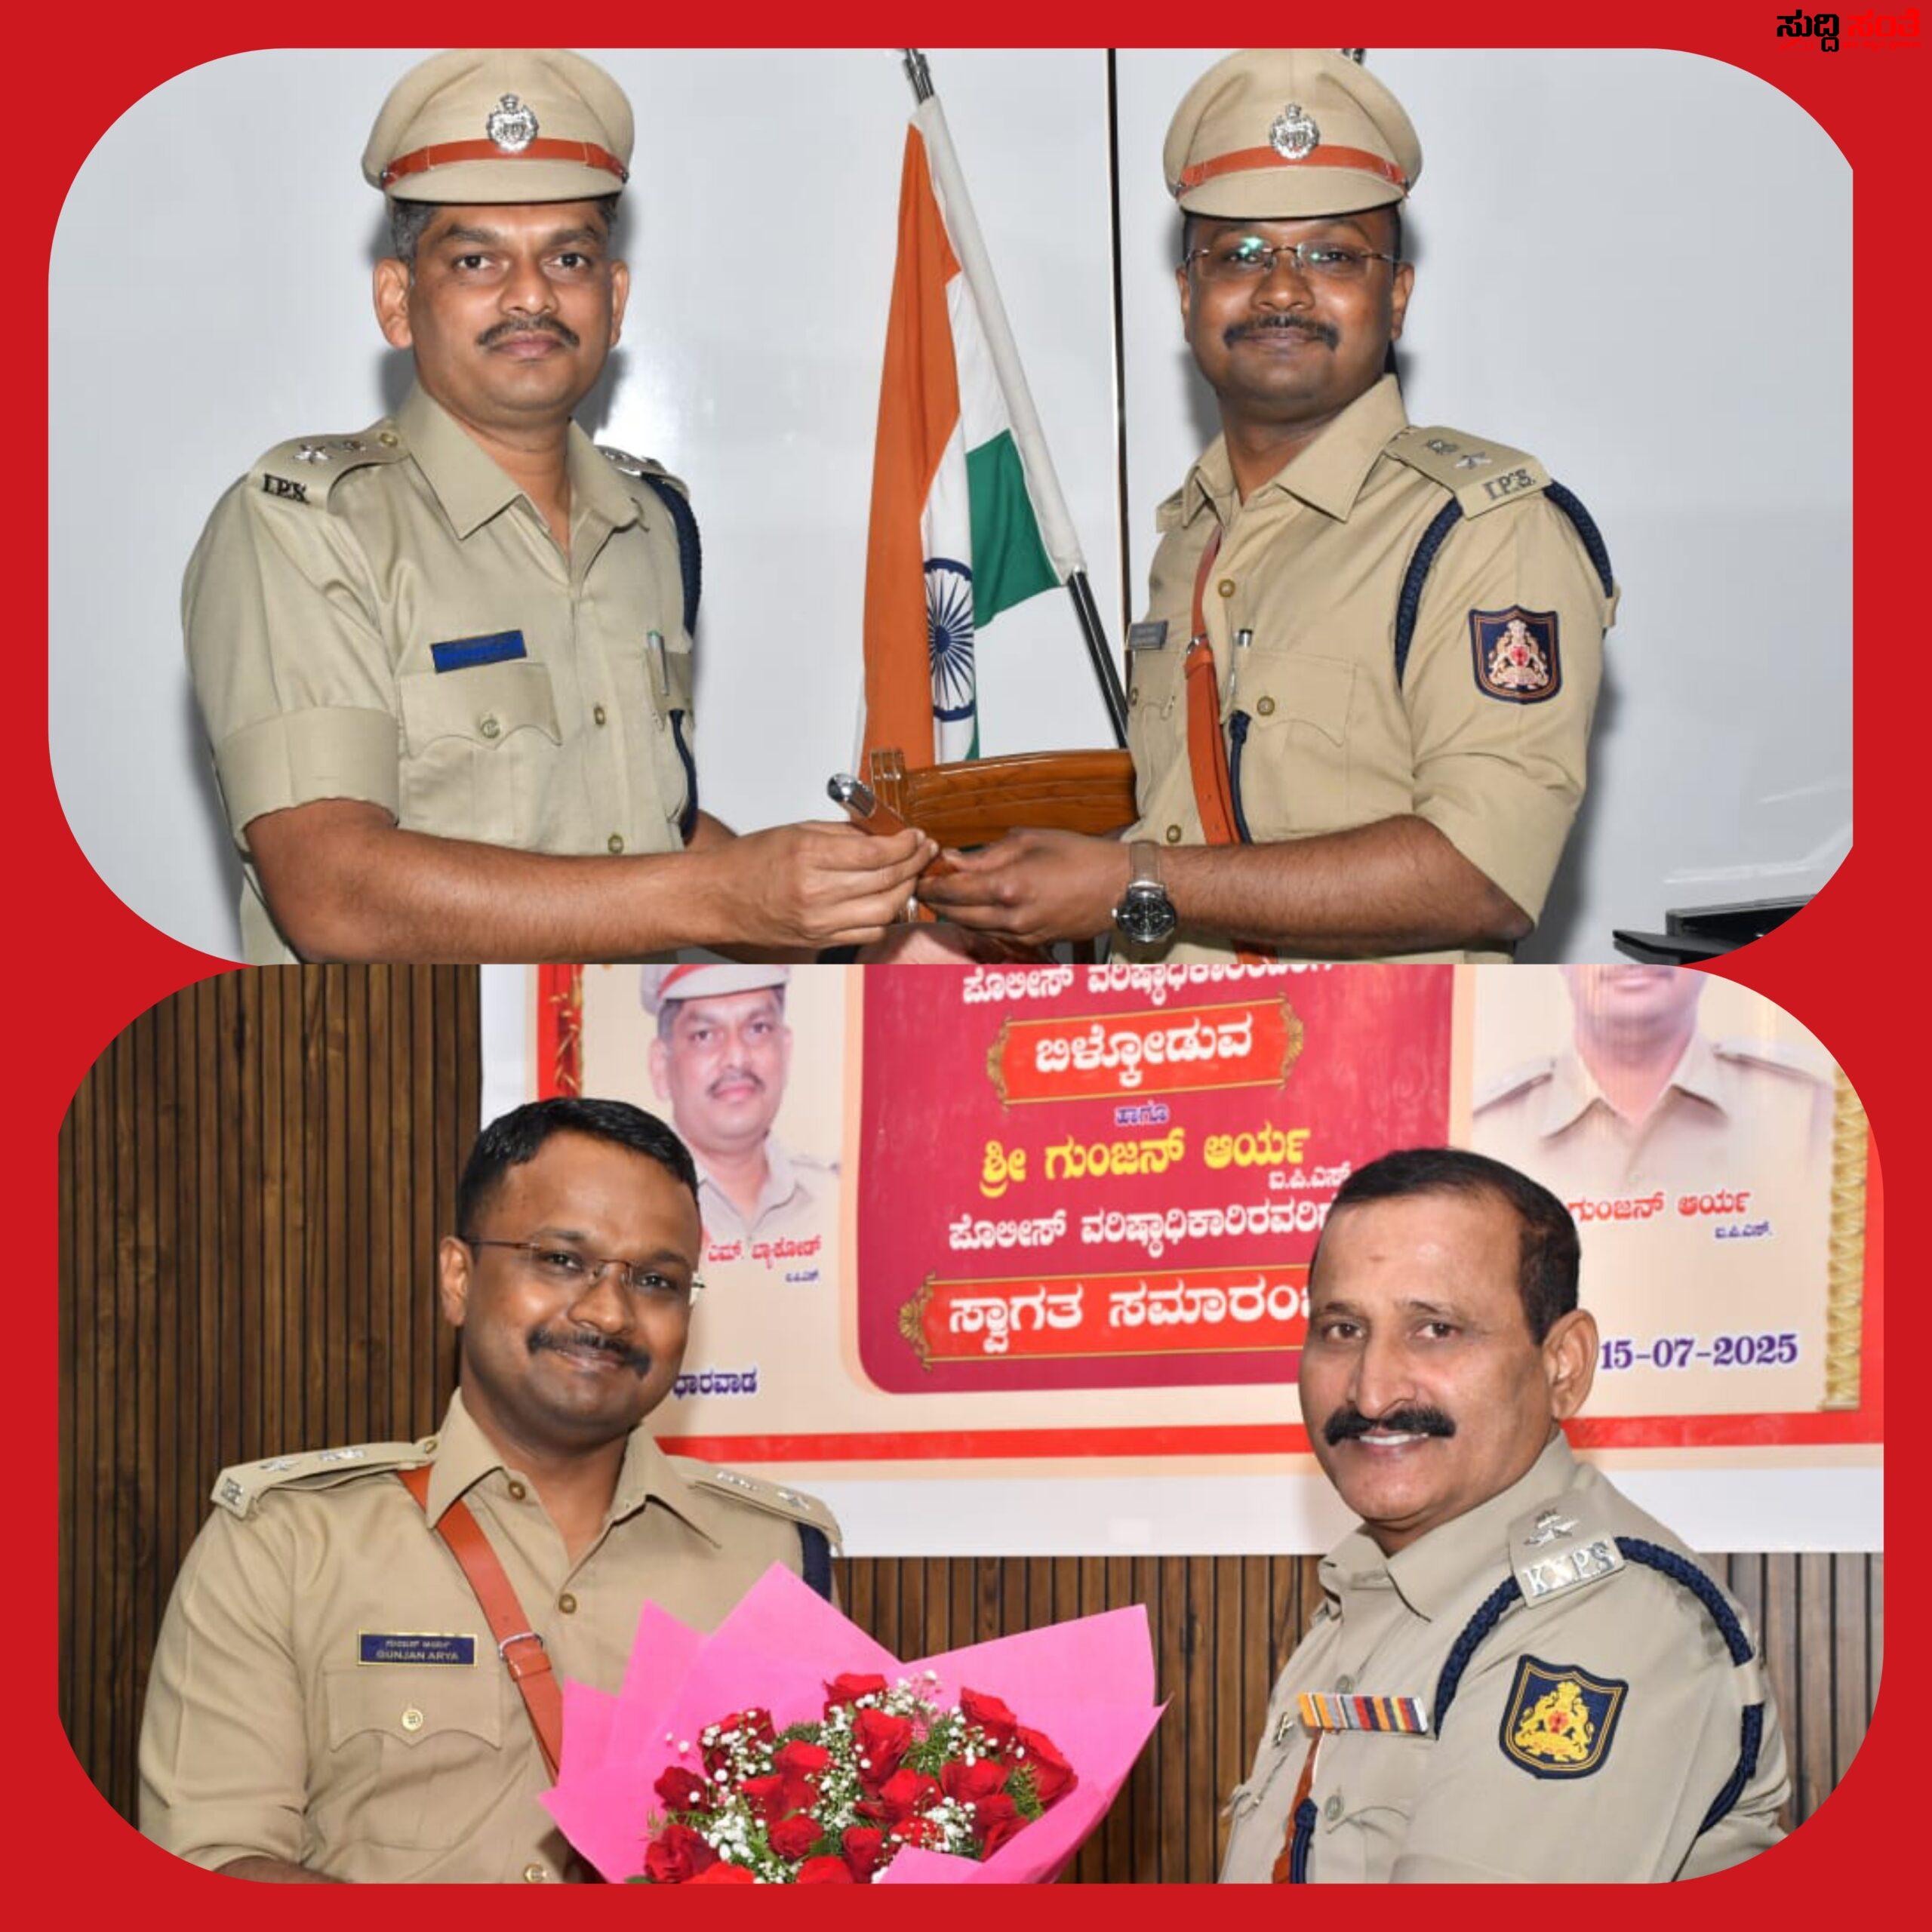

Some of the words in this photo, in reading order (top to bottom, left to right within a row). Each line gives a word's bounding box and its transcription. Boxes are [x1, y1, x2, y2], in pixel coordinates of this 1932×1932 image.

[980, 1140, 1026, 1198] ಶ್ರೀ
[1045, 1128, 1186, 1180] ಗುಂಜನ್
[1204, 1122, 1310, 1170] ಆರ್ಯ
[1567, 1192, 1664, 1222] ಗುಂಜನ್
[1677, 1188, 1751, 1217] ಆರ್ಯ
[949, 1208, 1067, 1251] ಪೊಲೀಸ್
[949, 1283, 1084, 1354] ಸ್ವಾಗತ
[1109, 1274, 1311, 1328] ಸಮಾರಂ
[1601, 1333, 1798, 1371] 15-07-2025
[673, 1366, 757, 1398] ಧಾರವಾಡ
[427, 1651, 459, 1660] ARYA
